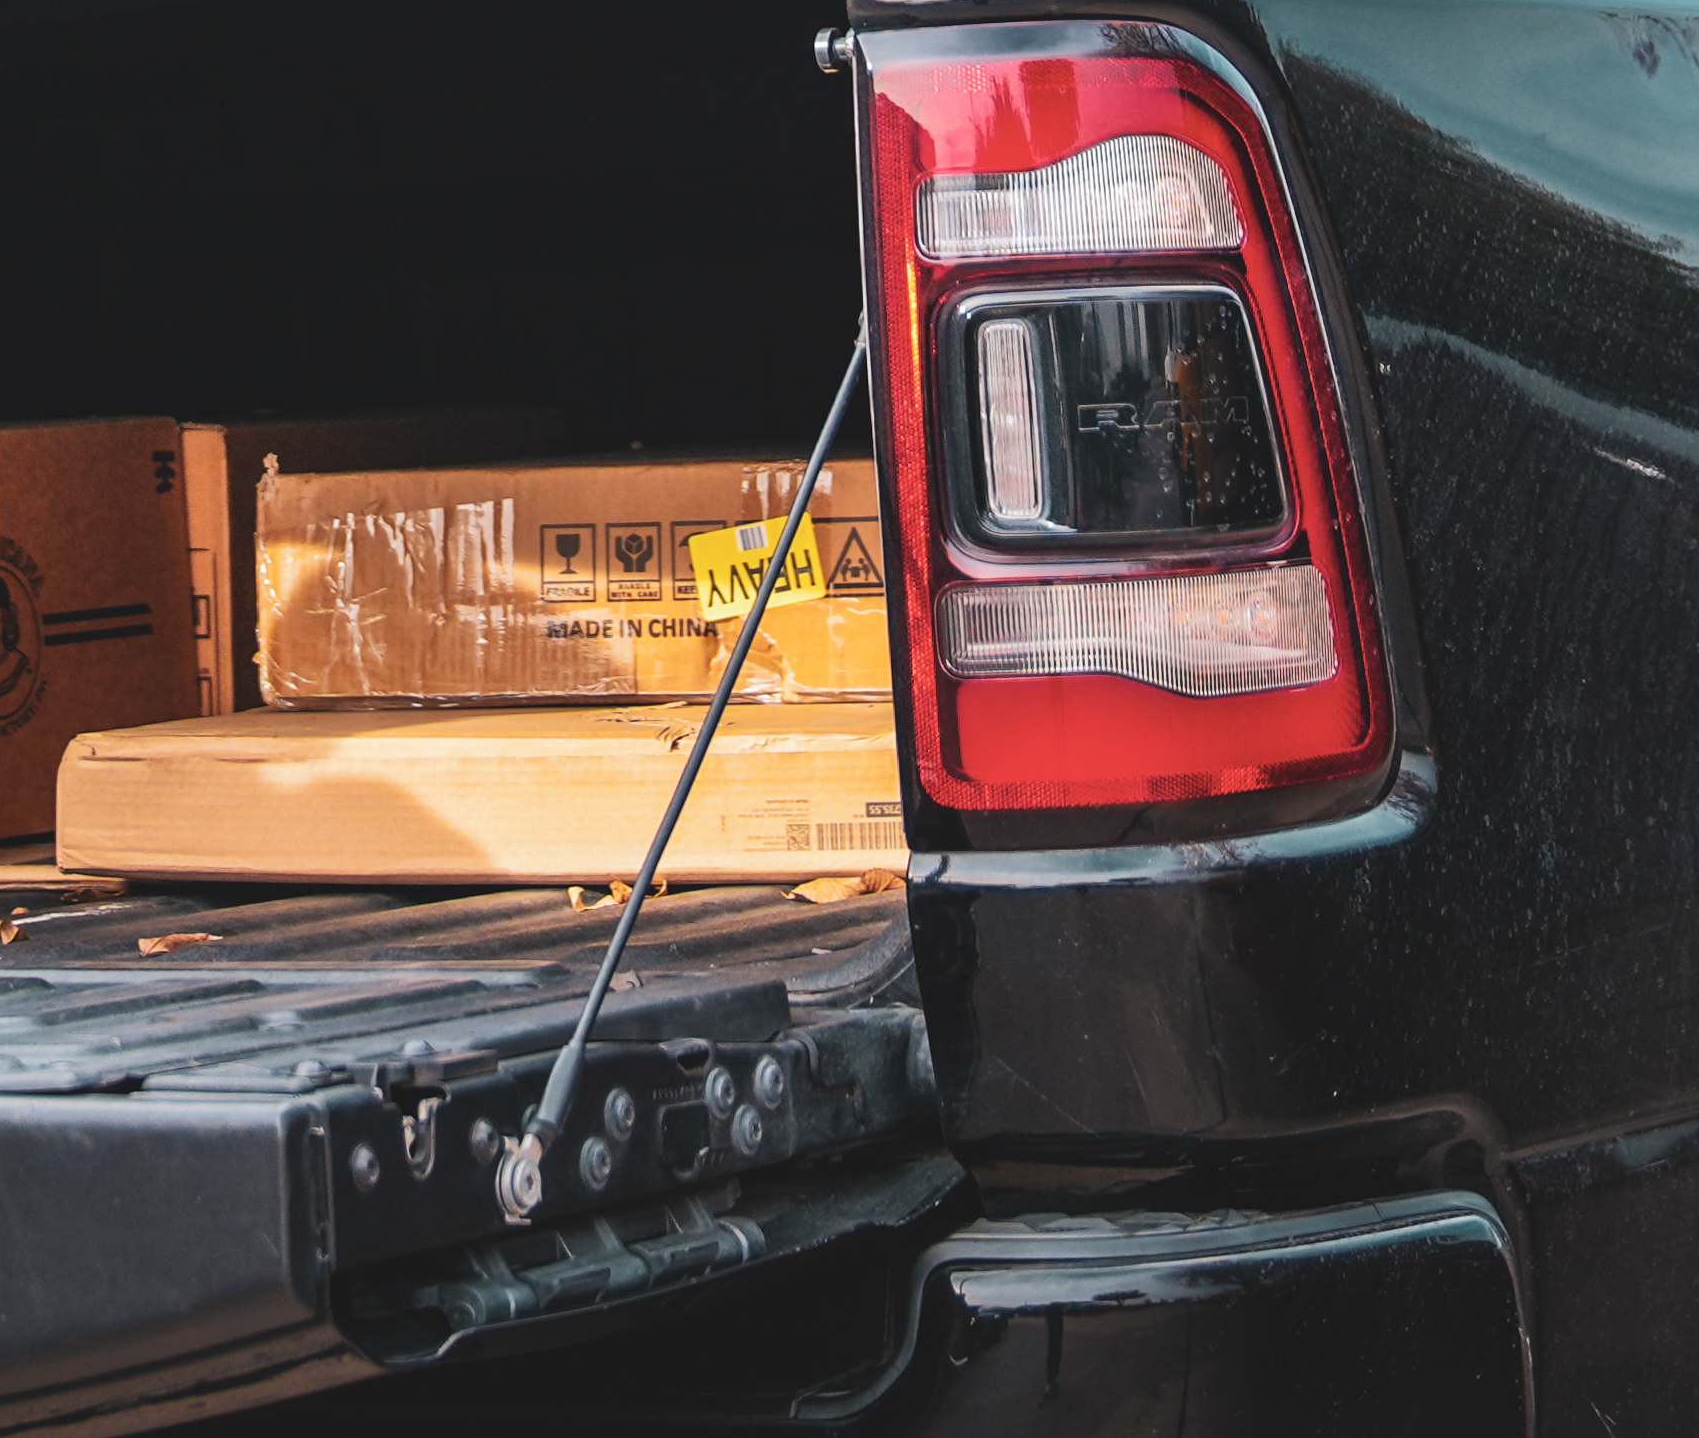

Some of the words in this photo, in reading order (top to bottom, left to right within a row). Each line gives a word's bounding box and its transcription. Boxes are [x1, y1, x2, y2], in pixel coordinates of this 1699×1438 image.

[1077, 396, 1249, 432] RAM
[707, 548, 817, 608] HEAVY
[546, 587, 590, 596] FRAGILE
[677, 585, 697, 594] KEE
[547, 619, 613, 638] MADE
[619, 619, 642, 637] IN
[649, 618, 717, 637] CHINA
